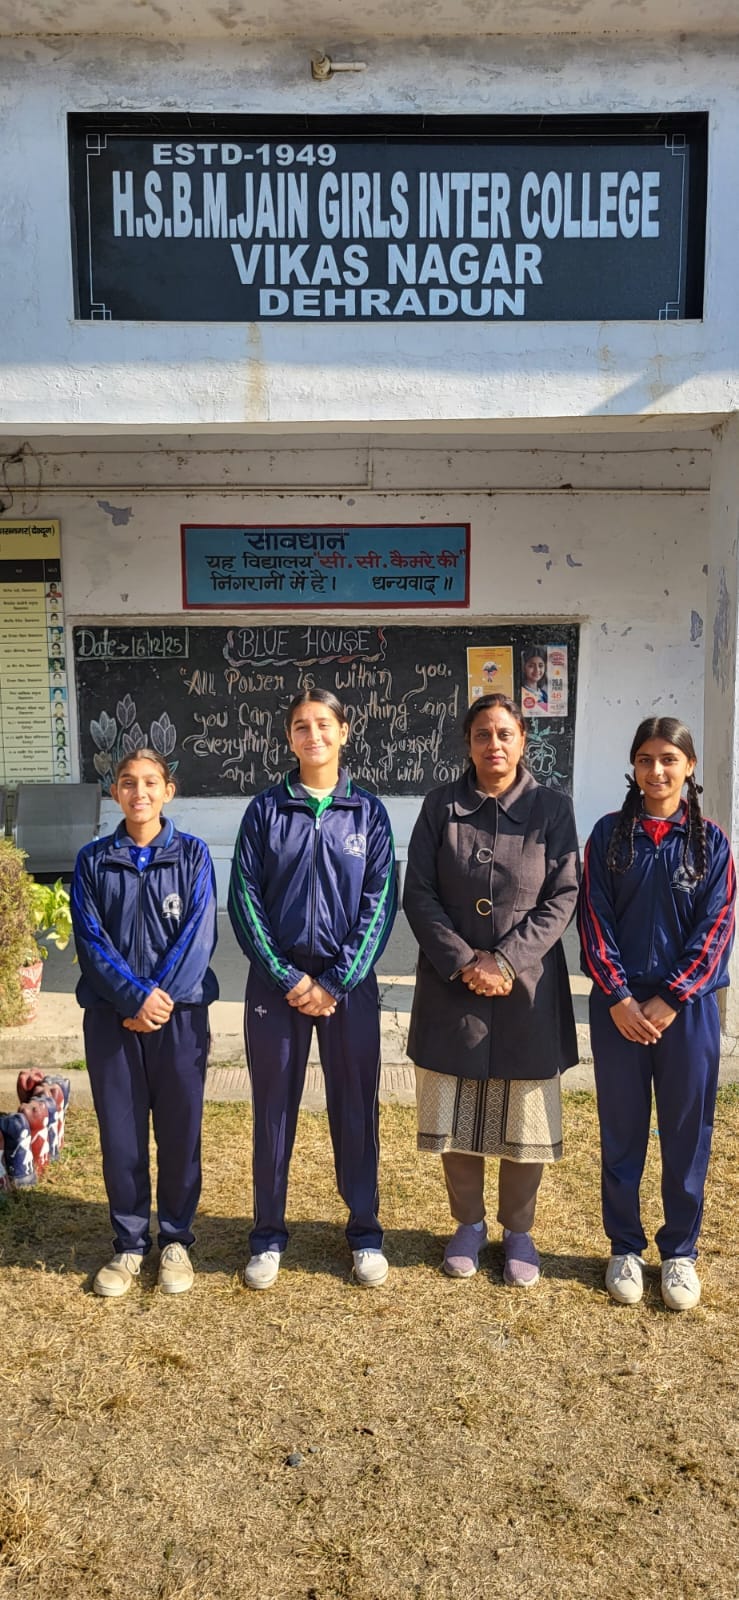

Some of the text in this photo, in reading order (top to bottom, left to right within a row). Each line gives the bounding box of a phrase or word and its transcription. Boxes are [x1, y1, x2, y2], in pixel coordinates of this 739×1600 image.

[152, 143, 337, 167] ESTD-1949
[112, 171, 661, 239] H.S.B.M.JAIN GIRLS INTER COLLEGE
[230, 243, 544, 285] VIKAS NAGAR
[259, 288, 526, 316] DEHRADUN
[244, 532, 350, 551] सावधान
[205, 555, 236, 573] यह
[242, 550, 313, 570] विद्यालय
[290, 570, 308, 591] में
[76, 628, 117, 656] Date
[238, 628, 371, 658] BLUE HOUSE
[335, 663, 392, 699] within
[184, 709, 229, 743] you
[343, 691, 409, 735] nything
[418, 685, 459, 732] and
